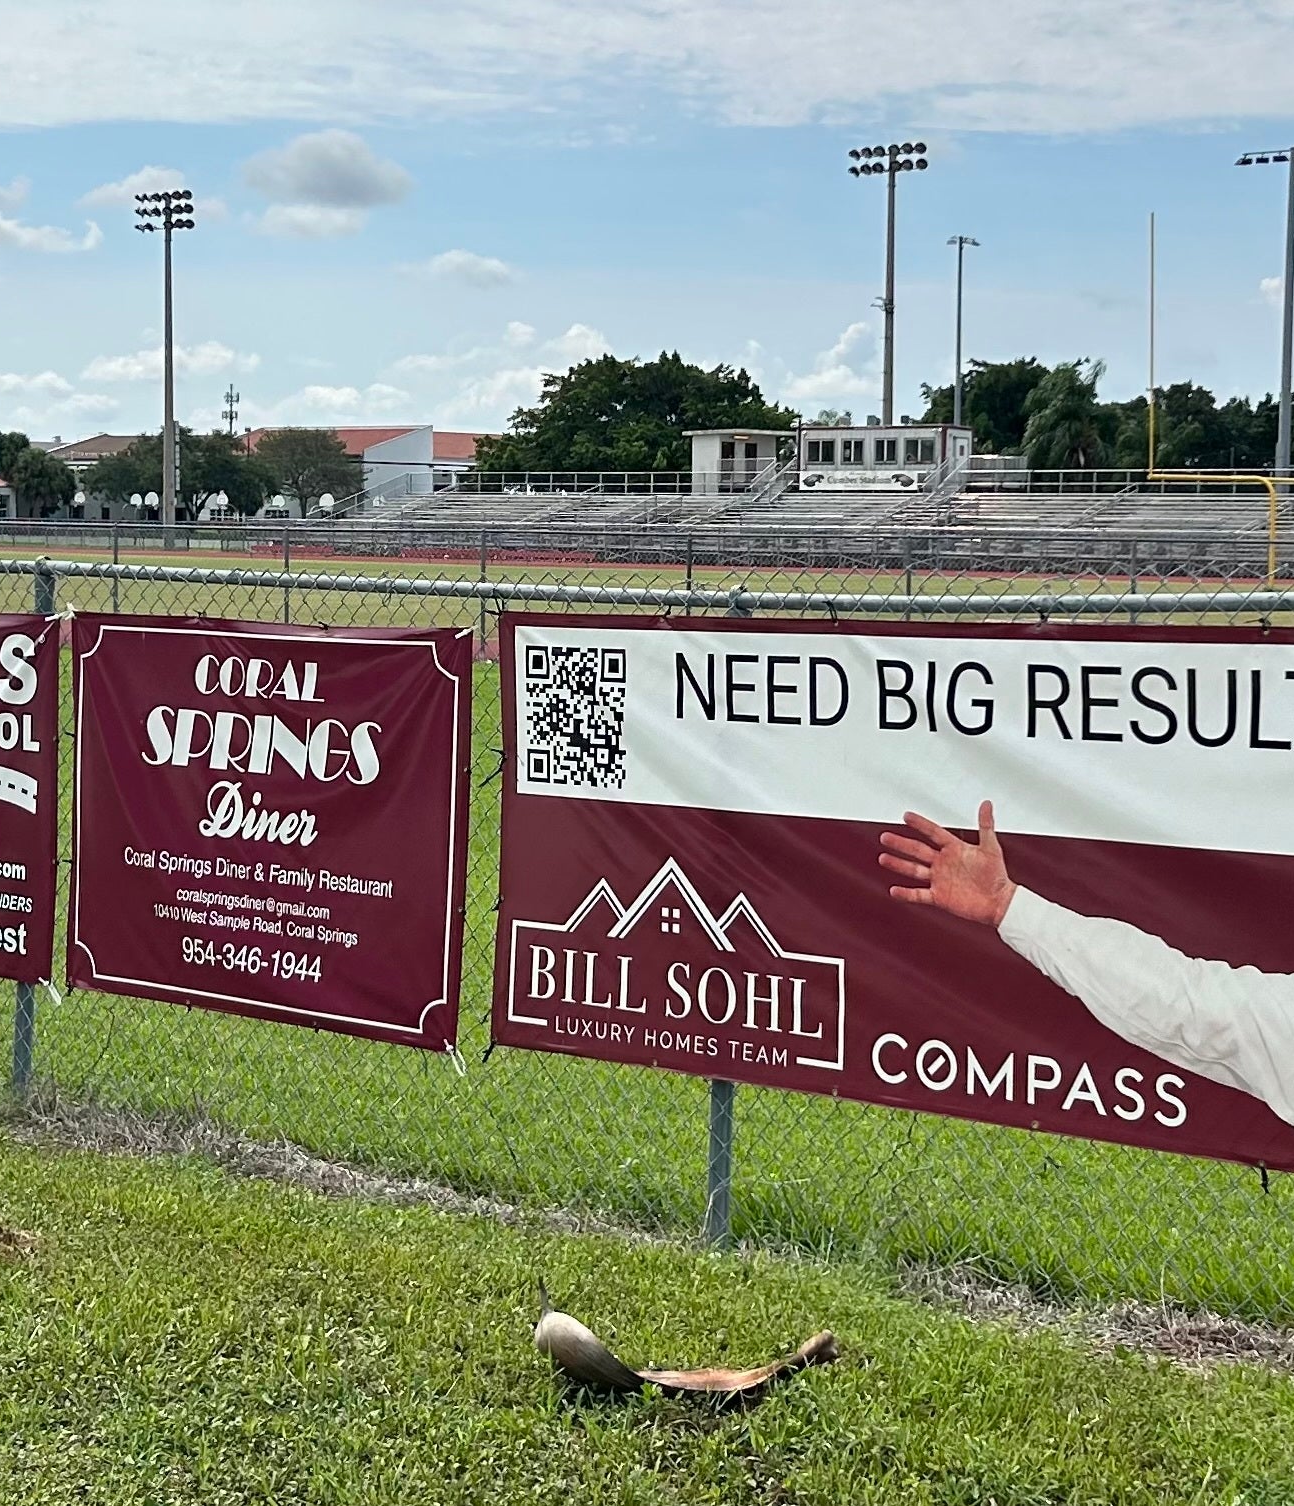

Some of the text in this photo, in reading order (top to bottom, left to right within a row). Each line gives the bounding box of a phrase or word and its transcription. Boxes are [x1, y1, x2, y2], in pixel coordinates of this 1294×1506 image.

[859, 475, 892, 484] Stadium
[195, 654, 325, 703] CORAL
[674, 652, 850, 728] NEED
[877, 659, 995, 736] BIG
[141, 705, 383, 785] SPRINGS
[199, 780, 319, 847] Diner
[124, 846, 393, 898] Coral Springs Diner & Family Restaurant
[153, 903, 359, 948] 10410 West Sample Road, Coral Springs
[176, 887, 331, 920] coralspringsdiner@gmail.com
[182, 936, 323, 984] 954-346-1944
[527, 944, 824, 1042] BILL SOHL
[554, 1014, 790, 1069] LUXURY HOMES TEAM
[872, 1032, 1190, 1129] COMPASS
